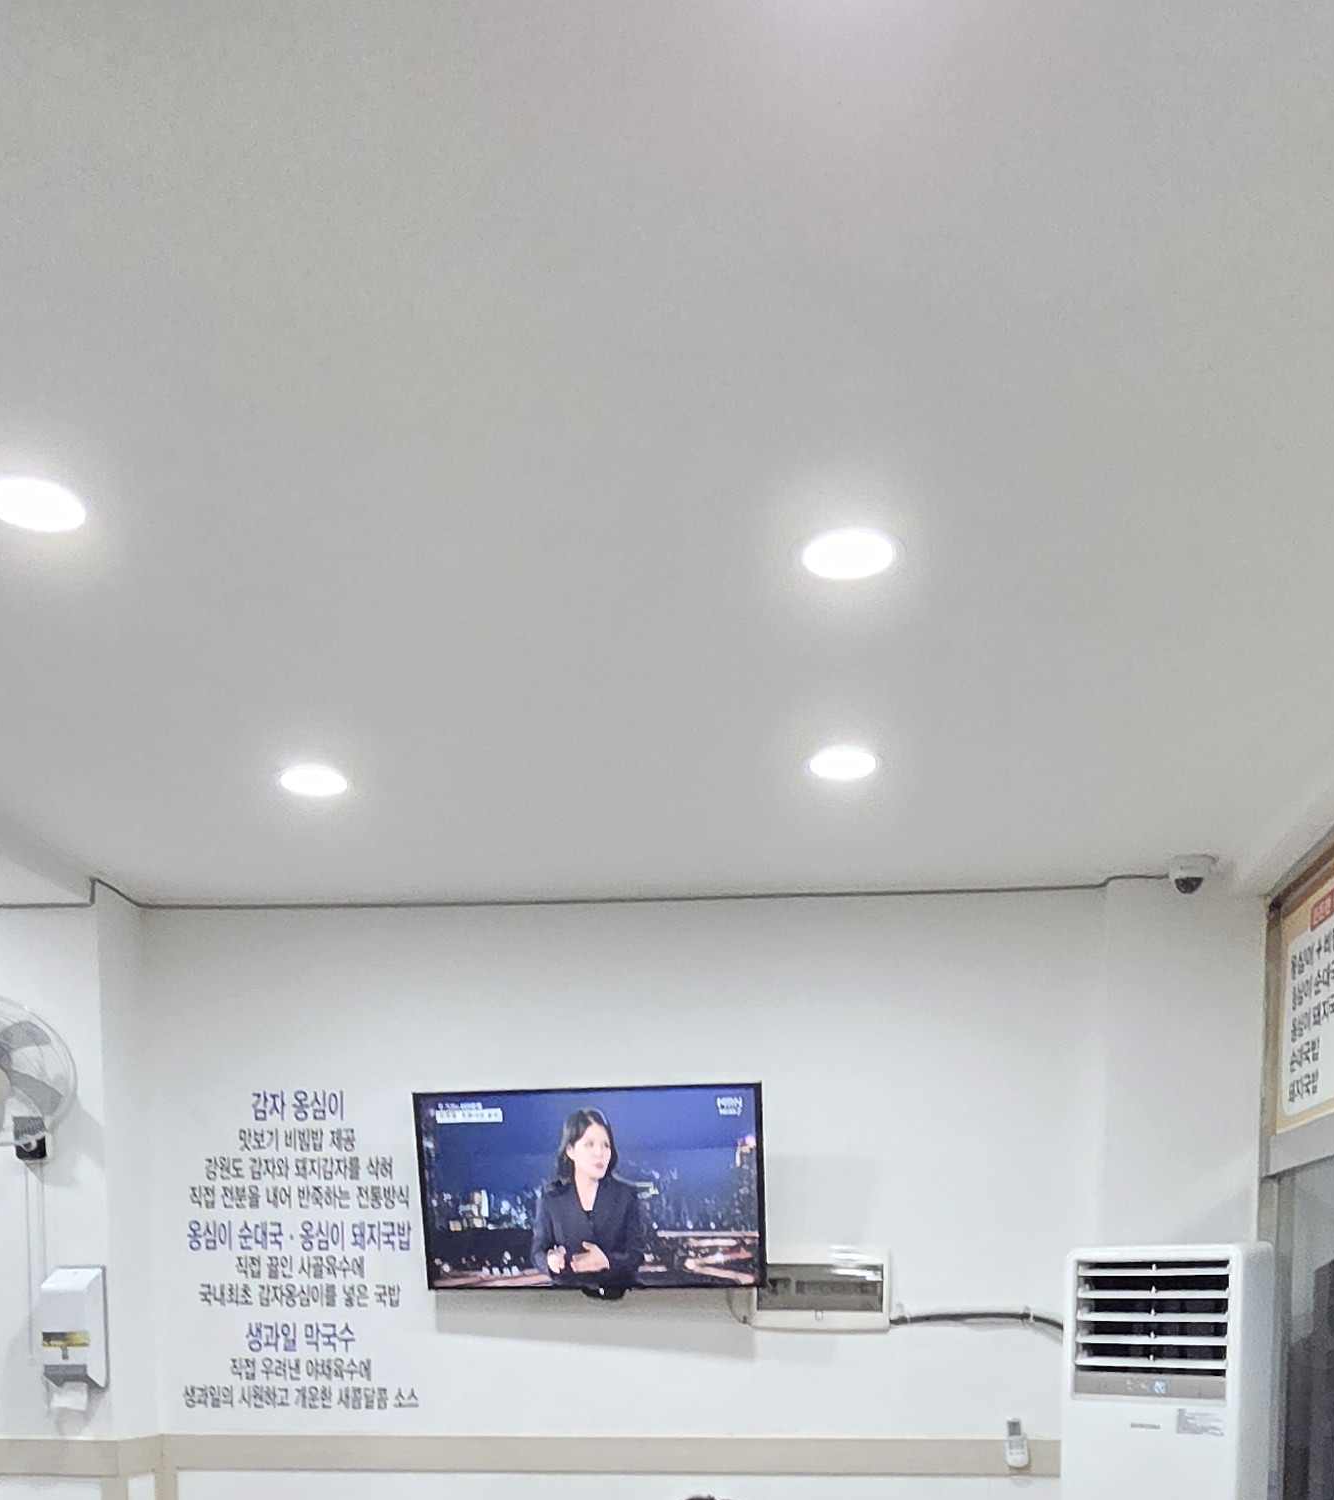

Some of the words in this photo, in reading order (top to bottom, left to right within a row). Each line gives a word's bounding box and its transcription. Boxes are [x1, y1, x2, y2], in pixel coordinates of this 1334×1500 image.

[252, 1090, 285, 1121] 감자
[292, 1090, 344, 1121] 옹심이
[239, 1128, 279, 1151] 맛보기
[284, 1128, 324, 1151] 비빔밥
[205, 1156, 245, 1181] 강원도
[249, 1156, 290, 1181] 감자와
[189, 1185, 215, 1209] 직접
[221, 1185, 261, 1209] 전분을
[267, 1185, 292, 1208] 내어
[297, 1185, 351, 1209] 반죽하는
[356, 1185, 410, 1209] 전통방식
[187, 1220, 232, 1251] 옹심이
[238, 1220, 284, 1251] 순대국
[299, 1220, 345, 1251] 옹심이
[351, 1220, 411, 1251] 돼지국밥
[235, 1255, 261, 1280] 직접
[298, 1255, 365, 1280] 사골육수에
[199, 1283, 253, 1308] 국내최초
[258, 1283, 338, 1308] 감자옹심이를
[374, 1283, 401, 1308] 국밥
[246, 1322, 297, 1352] 생과일
[304, 1322, 356, 1352] 막국수
[230, 1358, 256, 1381] 직접
[261, 1358, 301, 1381] 우려낸
[240, 1385, 290, 1409] 시원하고
[337, 1387, 388, 1410] 새콤달콤
[394, 1387, 420, 1408] 소스
